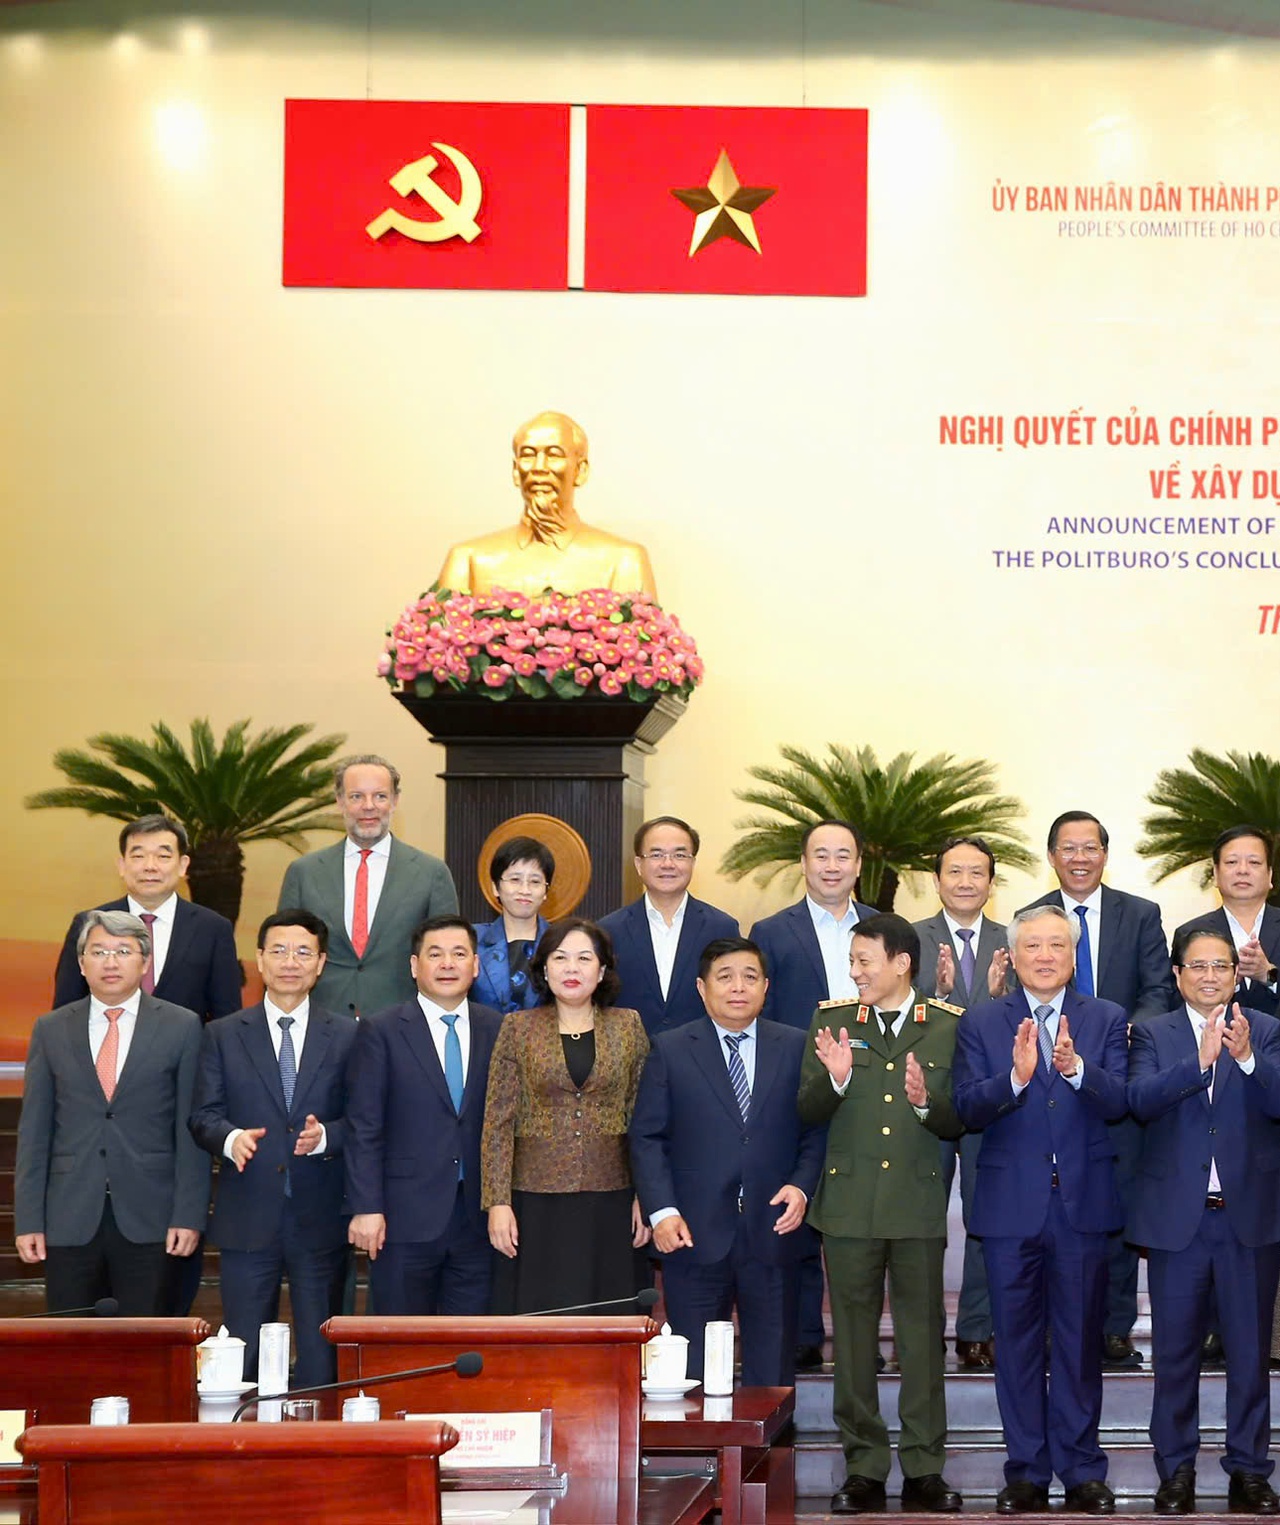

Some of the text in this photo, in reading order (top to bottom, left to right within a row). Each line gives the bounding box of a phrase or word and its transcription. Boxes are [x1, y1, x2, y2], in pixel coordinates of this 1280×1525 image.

[992, 178, 1019, 212] ỦY
[1026, 186, 1068, 212] BAN
[1075, 181, 1133, 212] NHÂN
[1139, 181, 1182, 212] DÂN
[1187, 181, 1259, 212] THÀNH
[1130, 219, 1216, 238] COMMITTEE
[1221, 220, 1239, 238] OF
[1244, 220, 1265, 238] HO
[940, 415, 1003, 452] NGHỊ
[1014, 407, 1097, 449] QUYẾT
[1106, 406, 1160, 446] CỦA
[1170, 410, 1252, 446] CHÍNH
[1149, 460, 1181, 499] VỀ
[1191, 463, 1243, 499] XÂY
[1047, 517, 1241, 534] ANNOUNCEMENT
[1247, 517, 1275, 535] OF
[992, 550, 1034, 568] THE
